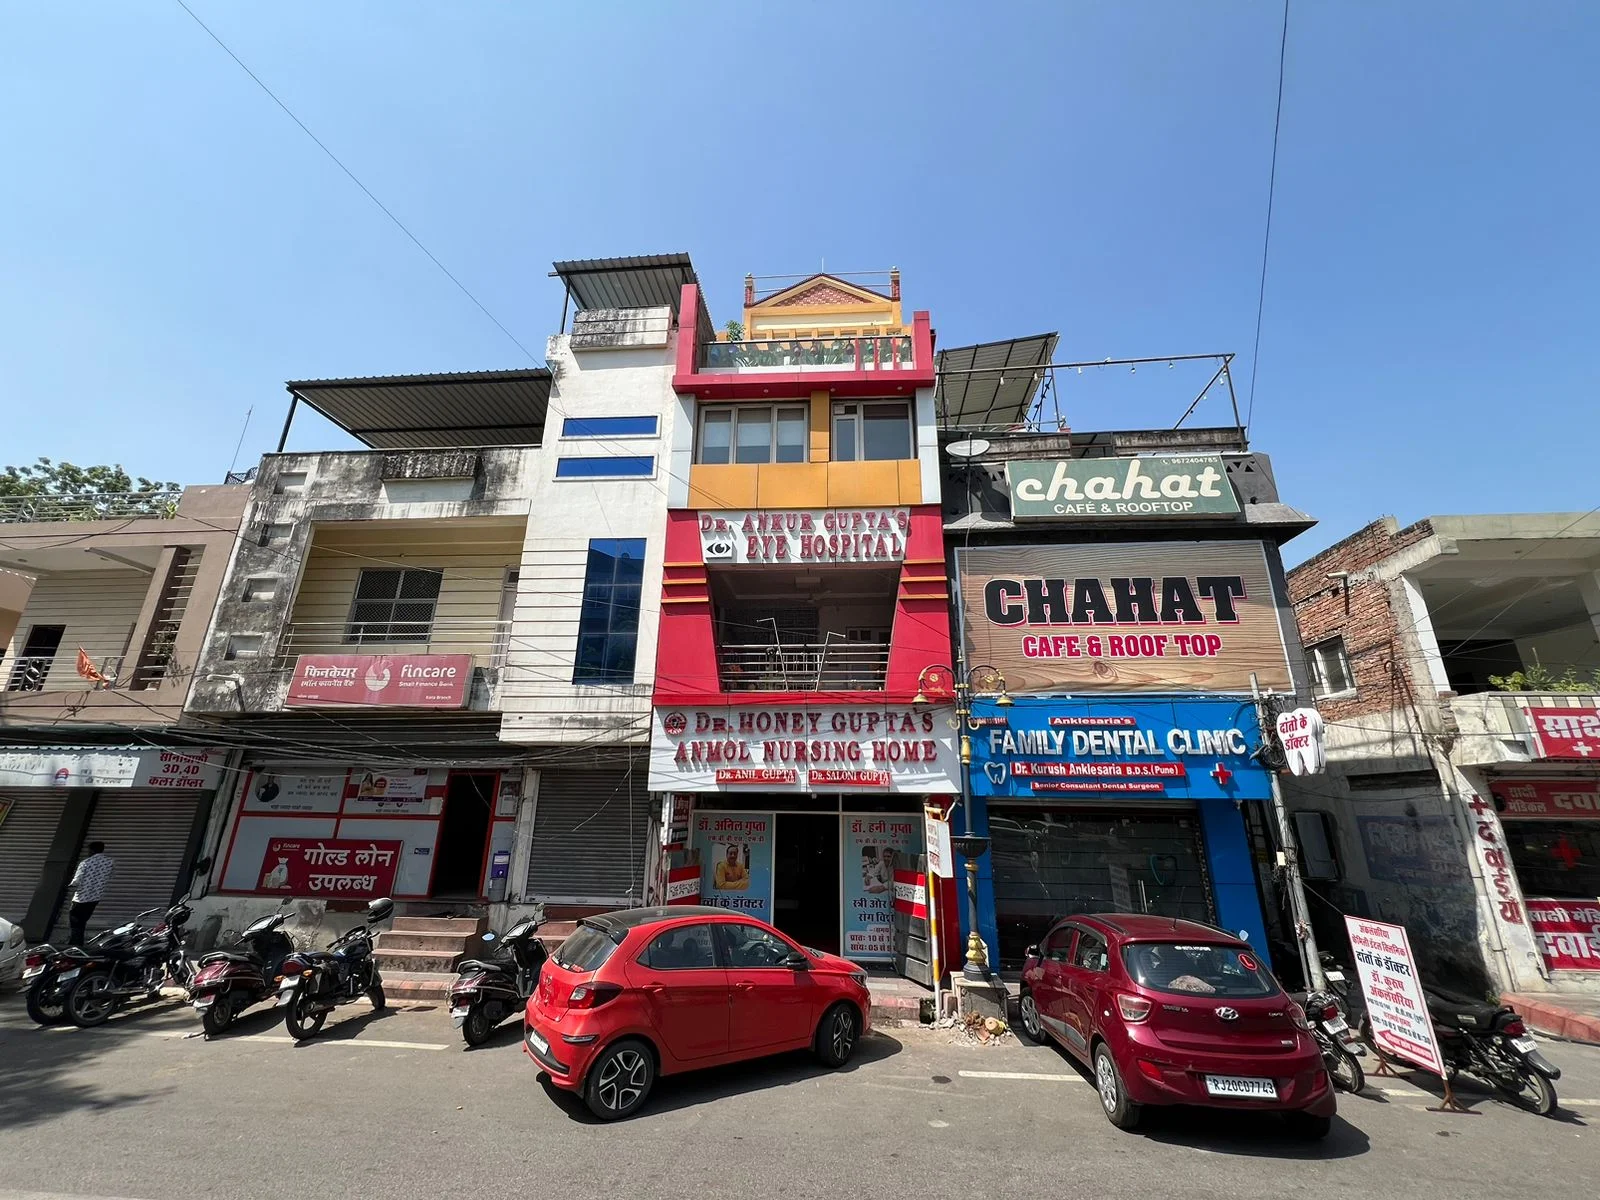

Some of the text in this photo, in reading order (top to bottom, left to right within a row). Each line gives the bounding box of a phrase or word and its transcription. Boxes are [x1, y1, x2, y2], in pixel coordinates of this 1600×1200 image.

[1016, 459, 1222, 501] chahat
[1053, 501, 1194, 514] CAFÉ & ROOFTOP
[741, 512, 815, 532] ANKUR
[824, 509, 909, 531] GUPTA'S
[746, 532, 902, 558] EYE HOSPITAL
[983, 575, 1248, 628] CHAHAT
[1022, 633, 1223, 659] CAFE & ROOF TOP
[304, 665, 358, 679] फिनकेयर
[400, 664, 456, 678] fincare
[738, 711, 822, 734] HONEY
[1053, 717, 1132, 725] Anklesaria's
[1299, 713, 1308, 729] के
[989, 728, 1247, 756] FAMILY DENTAL CLINIC
[1284, 733, 1310, 750] डॉक्टर
[673, 740, 938, 764] ANMOL NURSING HOME
[163, 764, 200, 775] 3D,4D
[735, 769, 759, 780] ANIL
[761, 769, 795, 780] GUPTA
[826, 770, 858, 781] SALONI
[859, 771, 889, 782] GUPTA
[1014, 762, 1028, 774] Dr.
[1030, 762, 1066, 775] Kurush
[1069, 763, 1122, 776] Anklesaria
[148, 775, 205, 787] कलर डॉप्लर
[714, 817, 743, 831] अनिल
[745, 820, 767, 836] गुप्ता
[868, 821, 886, 834] हनी
[889, 823, 913, 837] गुप्ता
[304, 842, 395, 867] गोल्ड लोन
[308, 874, 378, 891] उपलब्ध
[720, 895, 730, 909] के
[733, 895, 764, 909] डॉक्टर
[851, 897, 867, 908] स्त्री
[869, 898, 887, 908] और
[1527, 907, 1571, 923] साक्षी
[1373, 953, 1384, 968] के
[1383, 956, 1412, 977] डॉक्टर
[1213, 1078, 1274, 1094] RJ20CD7743
